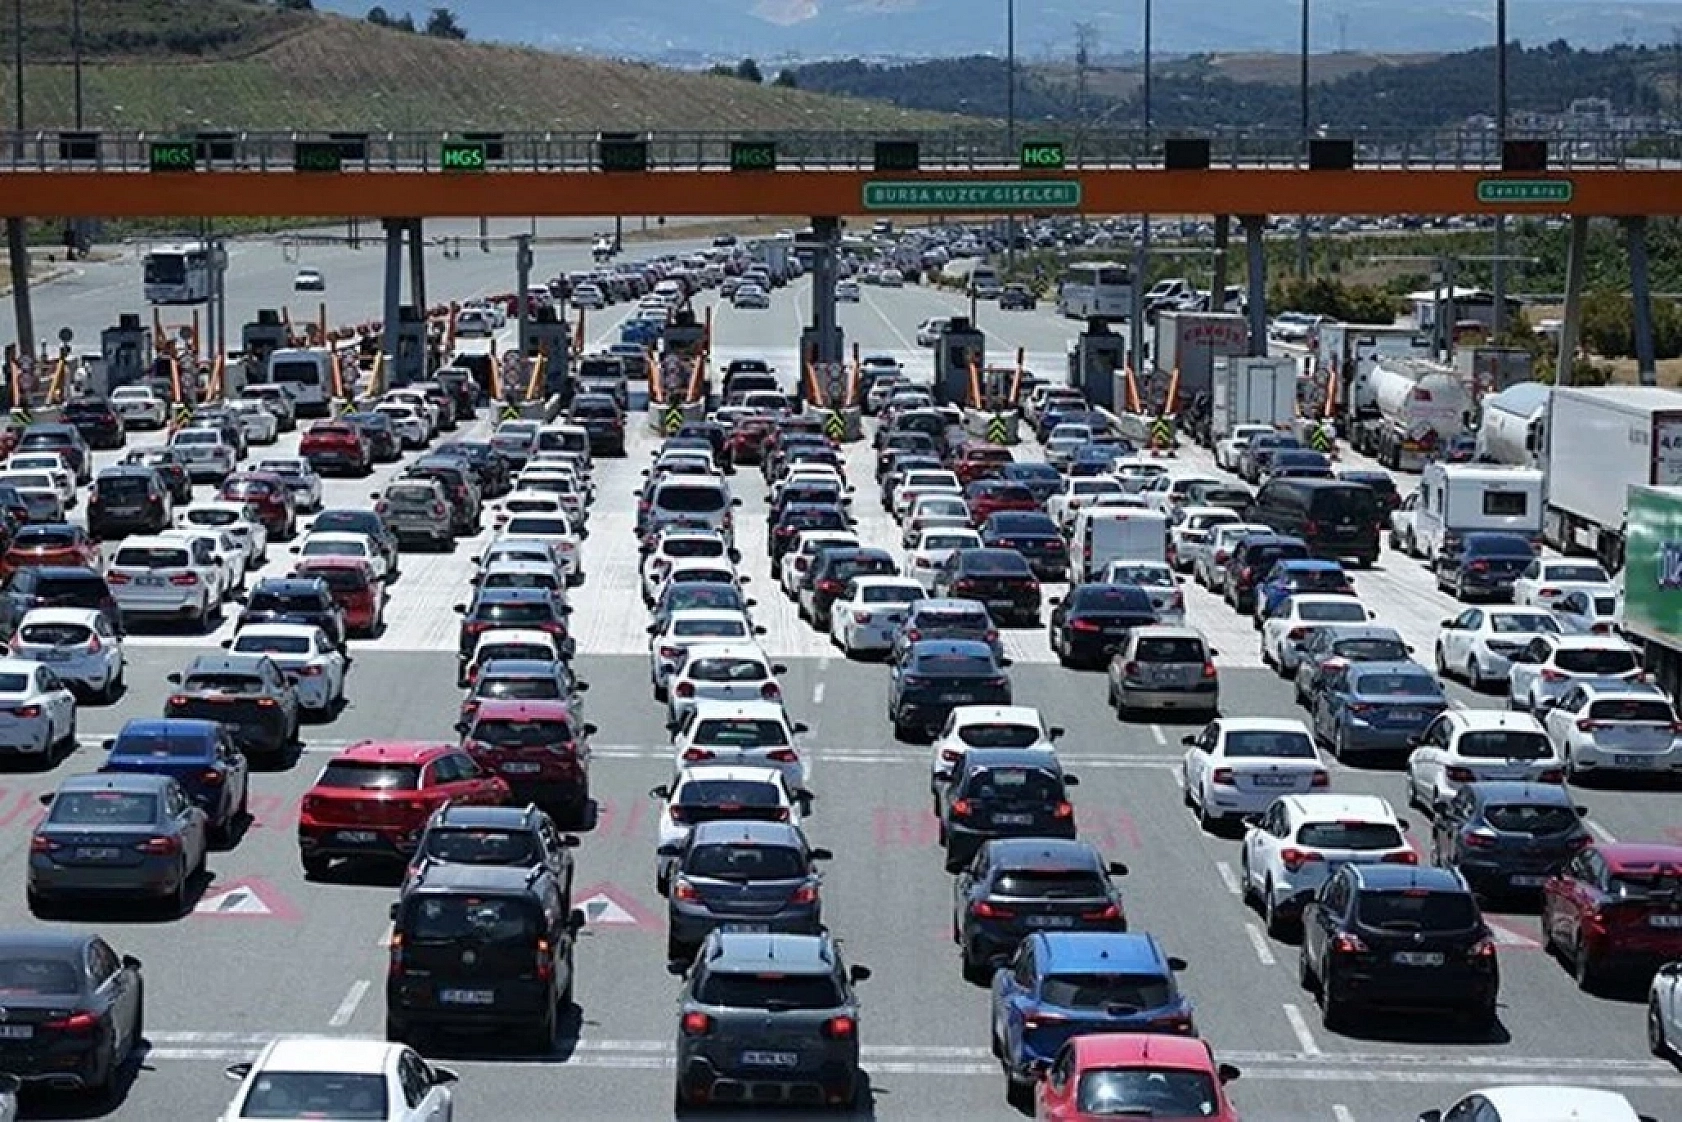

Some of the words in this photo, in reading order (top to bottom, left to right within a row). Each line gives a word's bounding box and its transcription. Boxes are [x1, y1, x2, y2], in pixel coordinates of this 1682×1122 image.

[154, 147, 190, 164] HGS
[444, 148, 482, 165] HGS
[736, 148, 771, 165] HGS
[1024, 147, 1061, 164] HGS
[876, 187, 930, 201] BURSA
[934, 187, 987, 201] KUZEY
